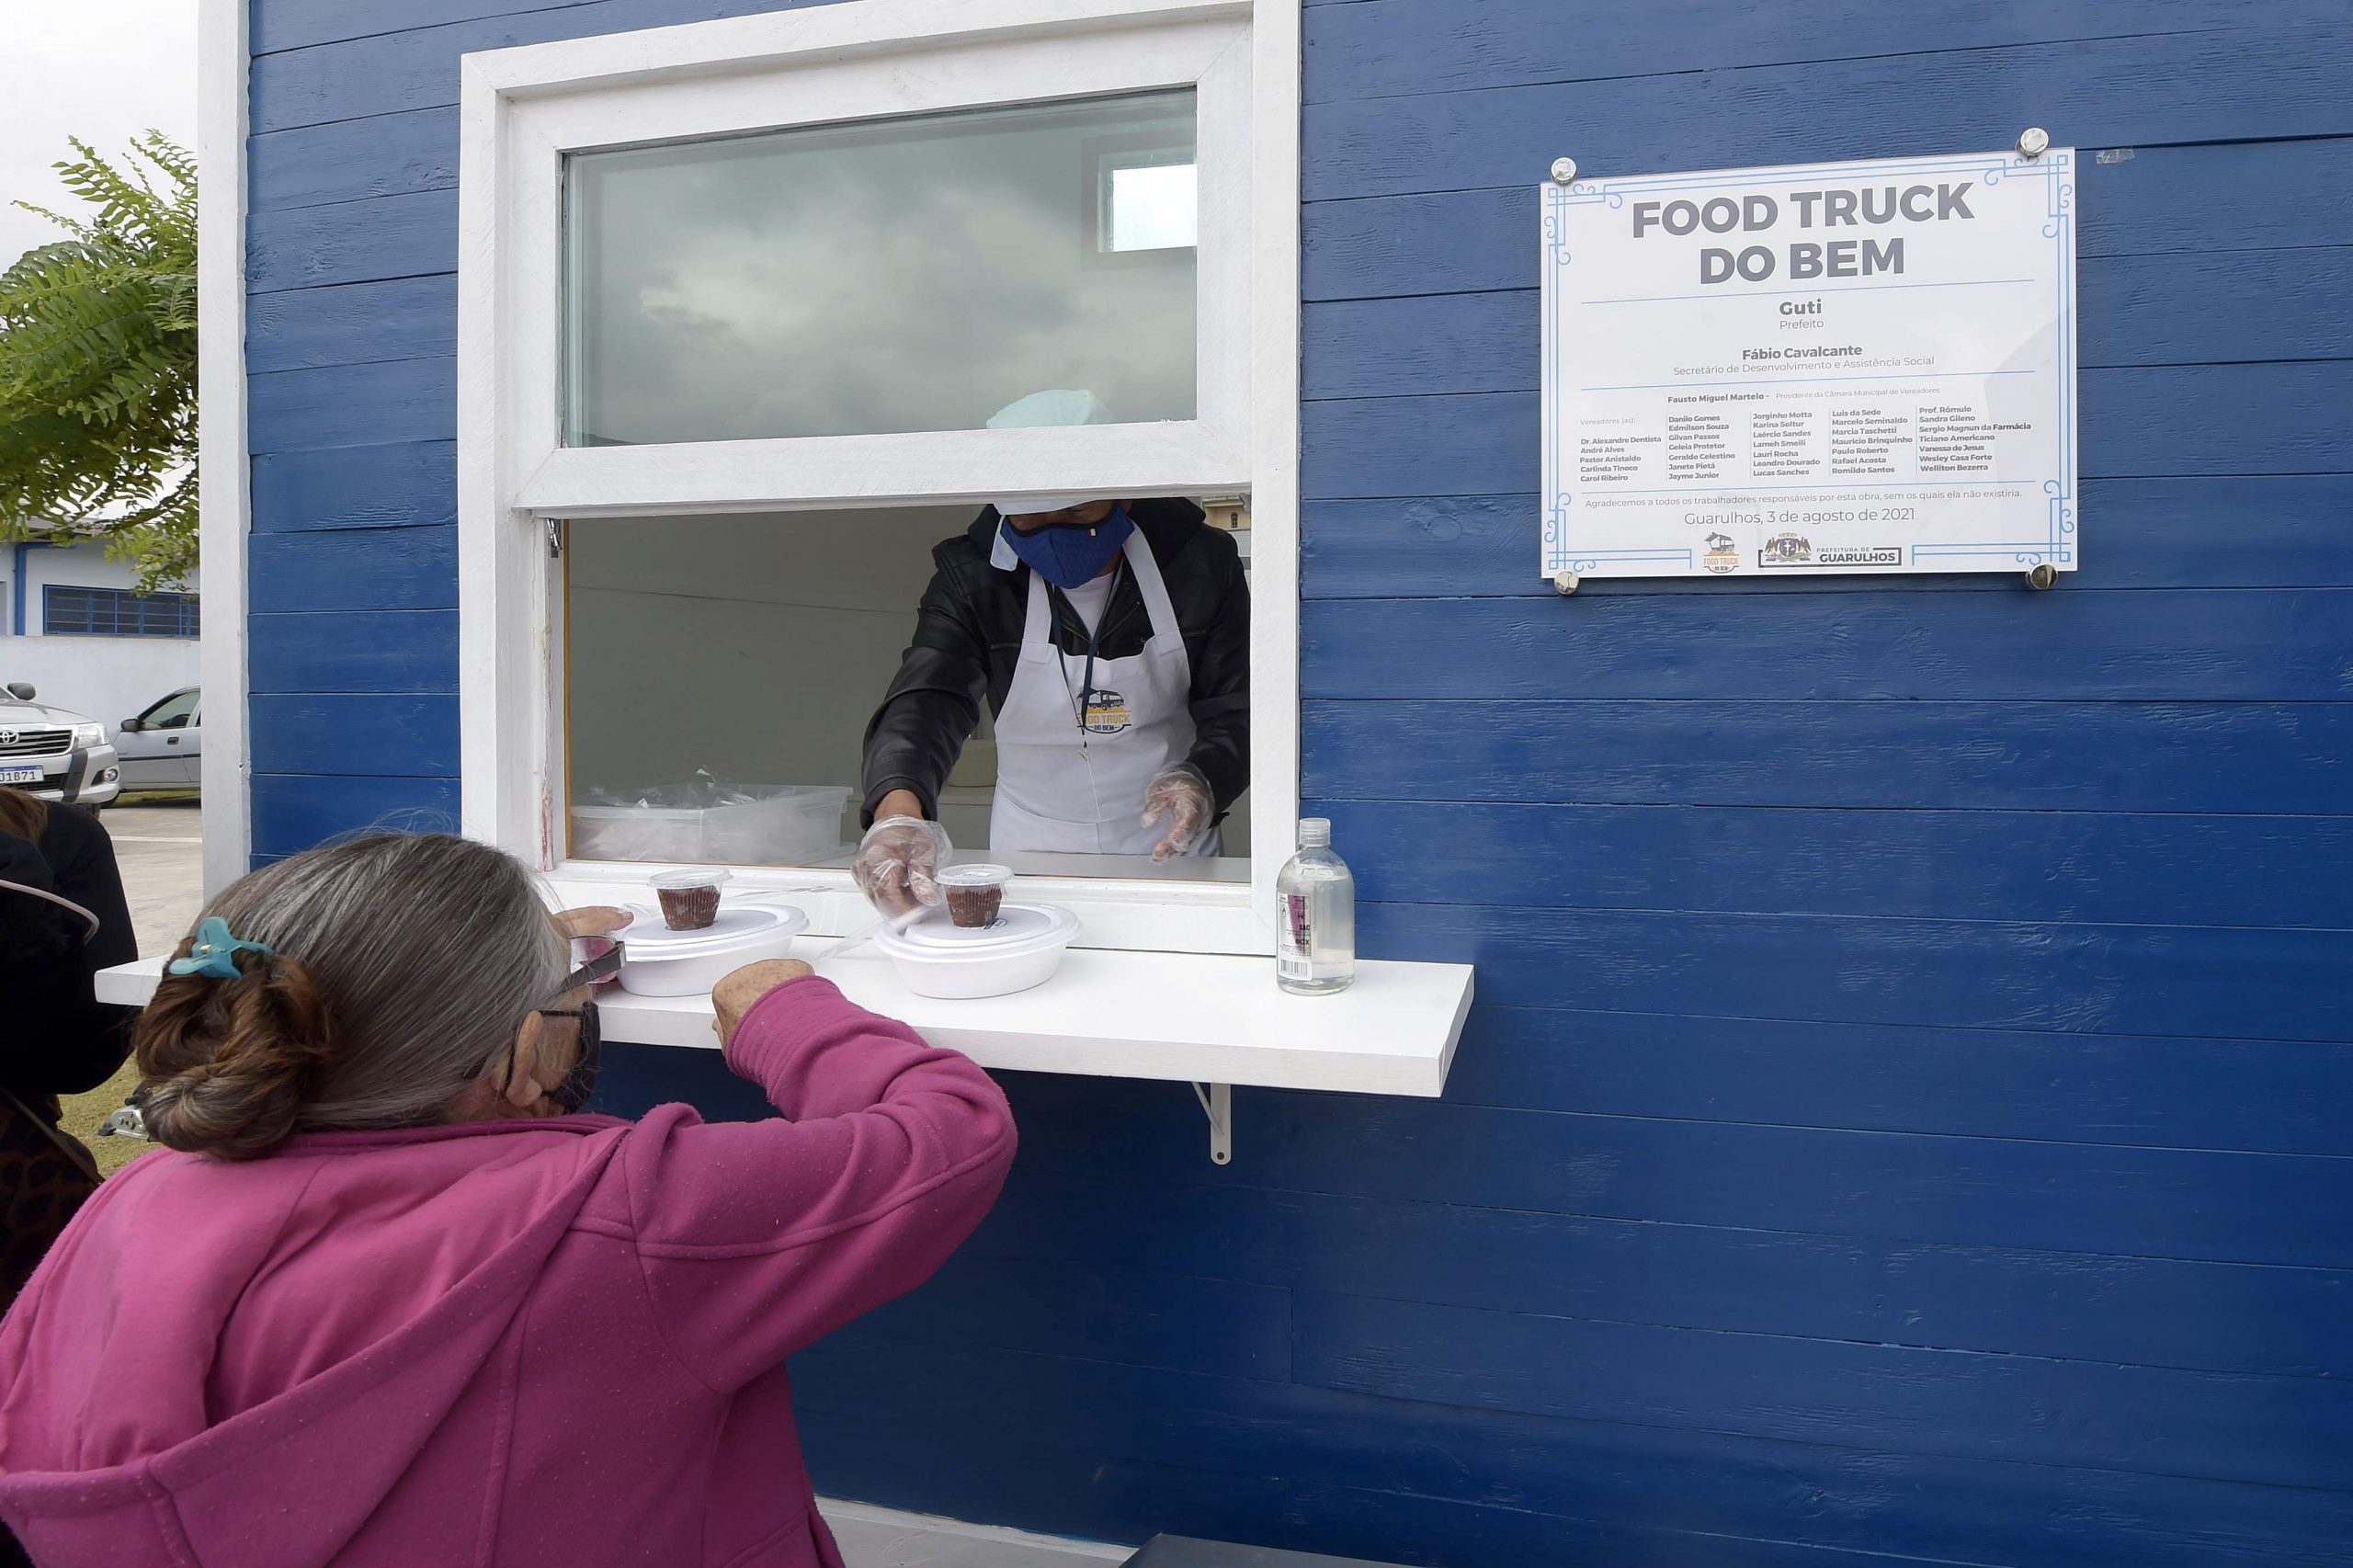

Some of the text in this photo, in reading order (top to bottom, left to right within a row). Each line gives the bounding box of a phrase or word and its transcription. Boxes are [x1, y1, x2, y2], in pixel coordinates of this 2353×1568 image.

[1632, 182, 1976, 238] FOOD TRUCK
[1700, 237, 1904, 285] DO BEM
[1779, 299, 1823, 315] Guti
[1779, 319, 1824, 330] Prefeito
[1742, 345, 1863, 361] Fábio Cavalcante
[1674, 356, 1935, 376] Secretário de Desenvolvimento e Assistência Social
[1667, 395, 1698, 403] Fausto
[1699, 393, 1728, 403] Miguel
[1730, 392, 1765, 401] Martelo
[1776, 392, 1813, 400] Presidente
[1854, 389, 1888, 397] Municipal
[1900, 387, 1940, 395] Vereadores
[1580, 417, 1620, 426] Vereadores
[1753, 413, 1788, 421] Jorginho
[1753, 430, 1781, 438] Laércio
[1859, 426, 1897, 435] Taschetti
[1919, 426, 1946, 434] Sergio
[1947, 425, 1980, 433] Magnun
[1867, 437, 1913, 445] Brinquinho
[1919, 455, 1949, 463] Wesley
[1920, 464, 1956, 472] Welliton
[1586, 499, 1646, 509] Agradecemos
[1694, 494, 1756, 505] trabalhadores
[1758, 494, 1817, 504] responsáveis
[1819, 494, 1835, 503] por
[1859, 493, 1882, 501] obra,
[1918, 491, 1945, 501] quais
[1947, 490, 1961, 499] ela
[1983, 489, 2022, 498] existiria.
[1684, 507, 1915, 526] Guarulhos, 3 de agosto de 2021
[1819, 552, 1895, 562] GUARULHOS
[1101, 714, 1131, 724] TRUCK
